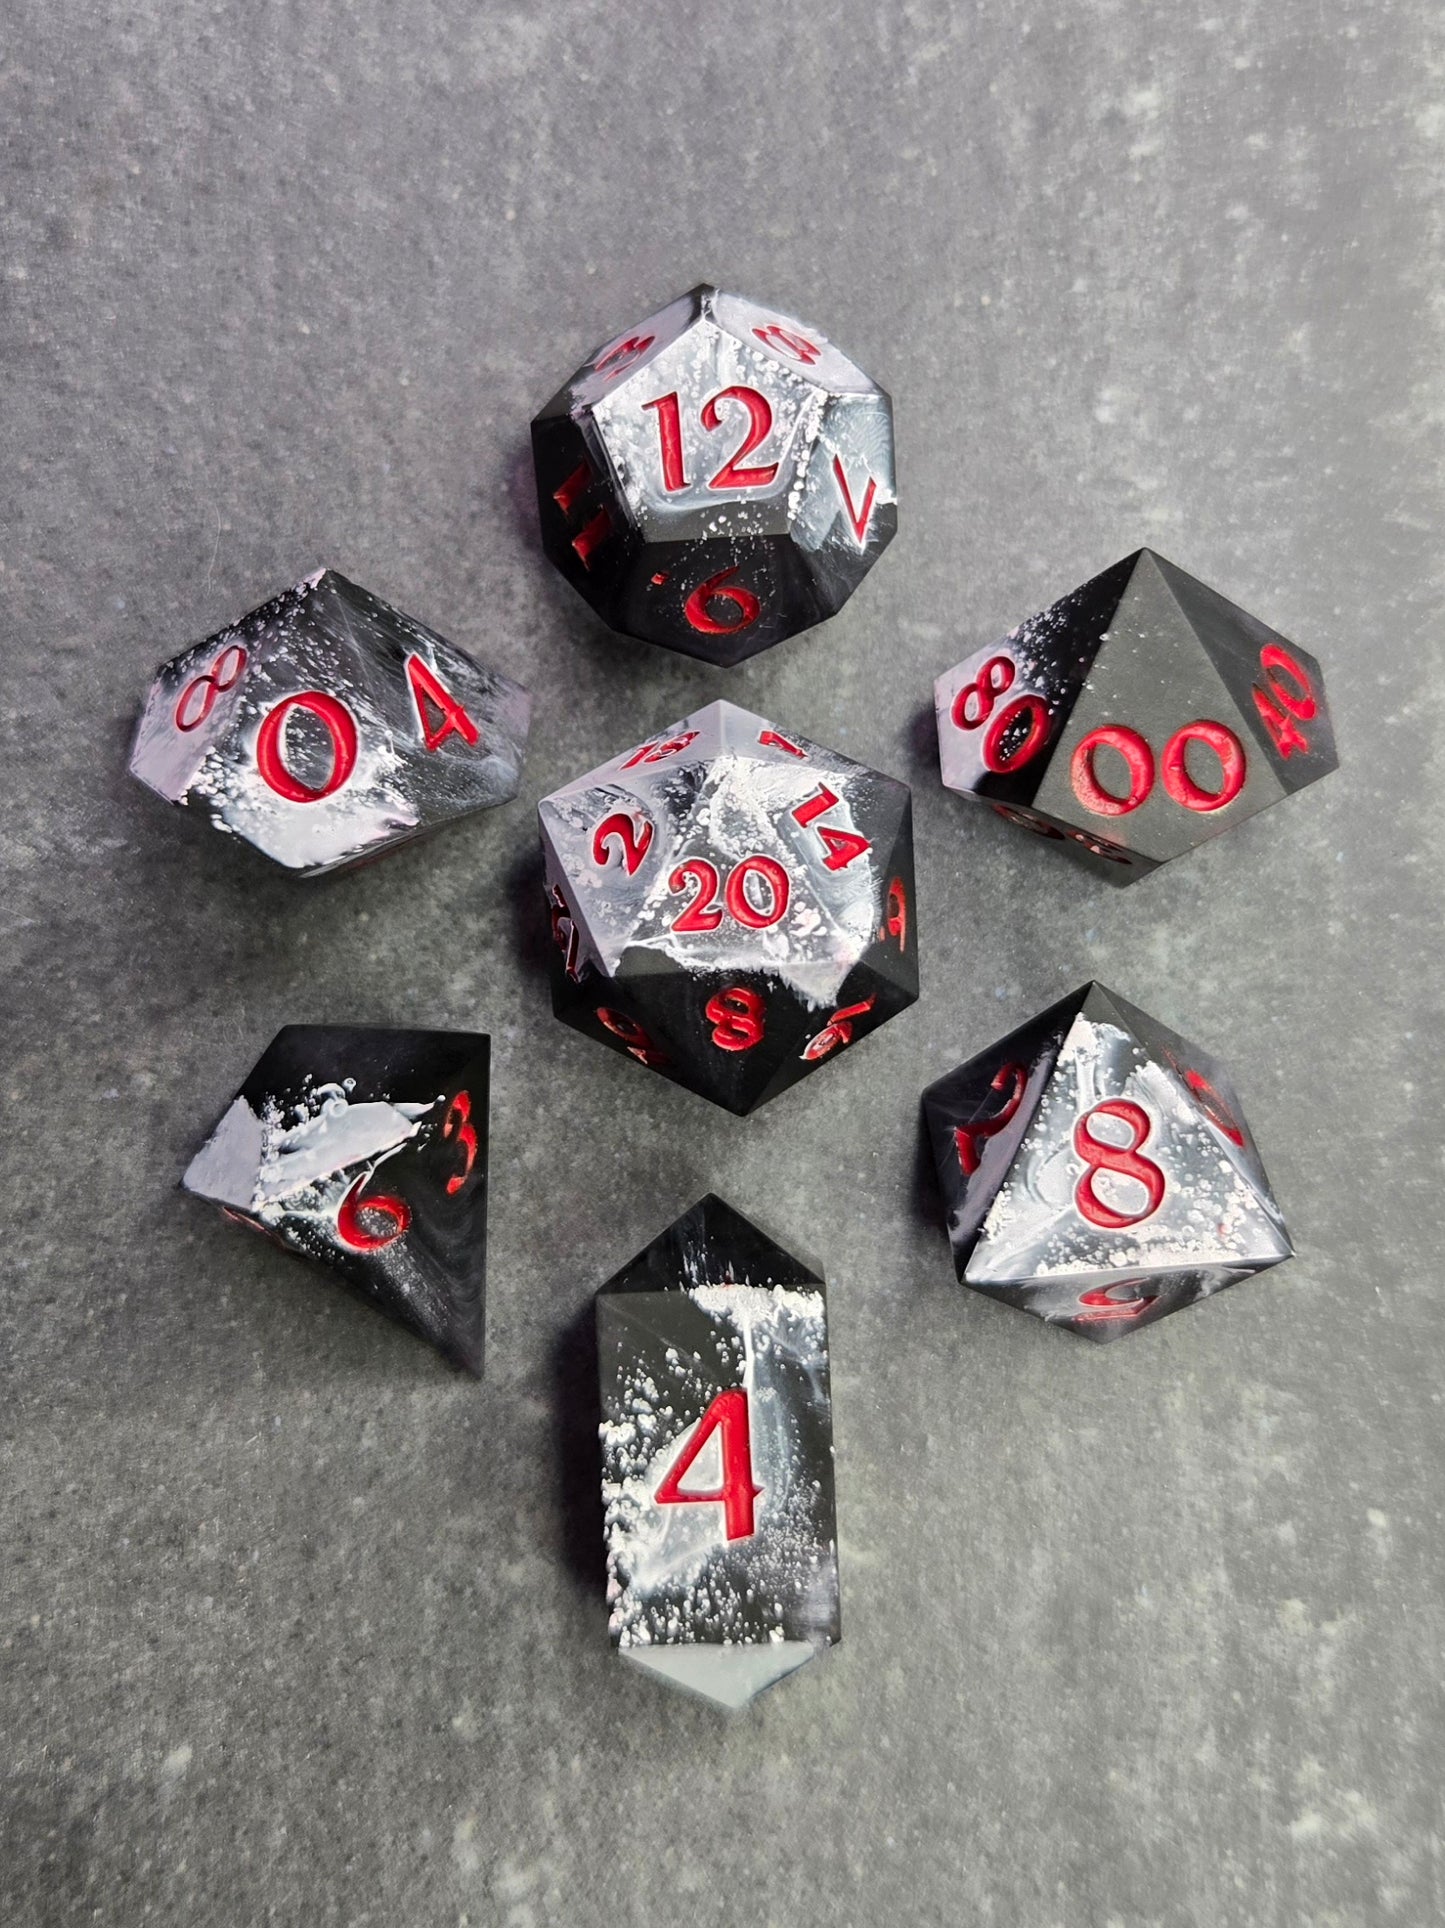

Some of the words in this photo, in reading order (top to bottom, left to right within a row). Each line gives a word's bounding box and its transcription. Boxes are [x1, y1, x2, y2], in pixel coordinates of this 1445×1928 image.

[640, 385, 780, 492] 12
[174, 644, 249, 734] 8
[405, 653, 482, 753] 4
[951, 655, 1053, 775] 80
[1251, 643, 1319, 762] 40
[255, 689, 358, 805] 0
[1071, 717, 1249, 818] 00
[593, 812, 655, 876] 2
[790, 782, 873, 872] 14
[668, 853, 791, 933] 20
[705, 986, 767, 1053] 8
[442, 1089, 479, 1197] 3
[952, 1060, 1030, 1177] 2
[1073, 1098, 1167, 1229] 8
[337, 1173, 412, 1253] 6
[654, 1388, 766, 1542] 4
